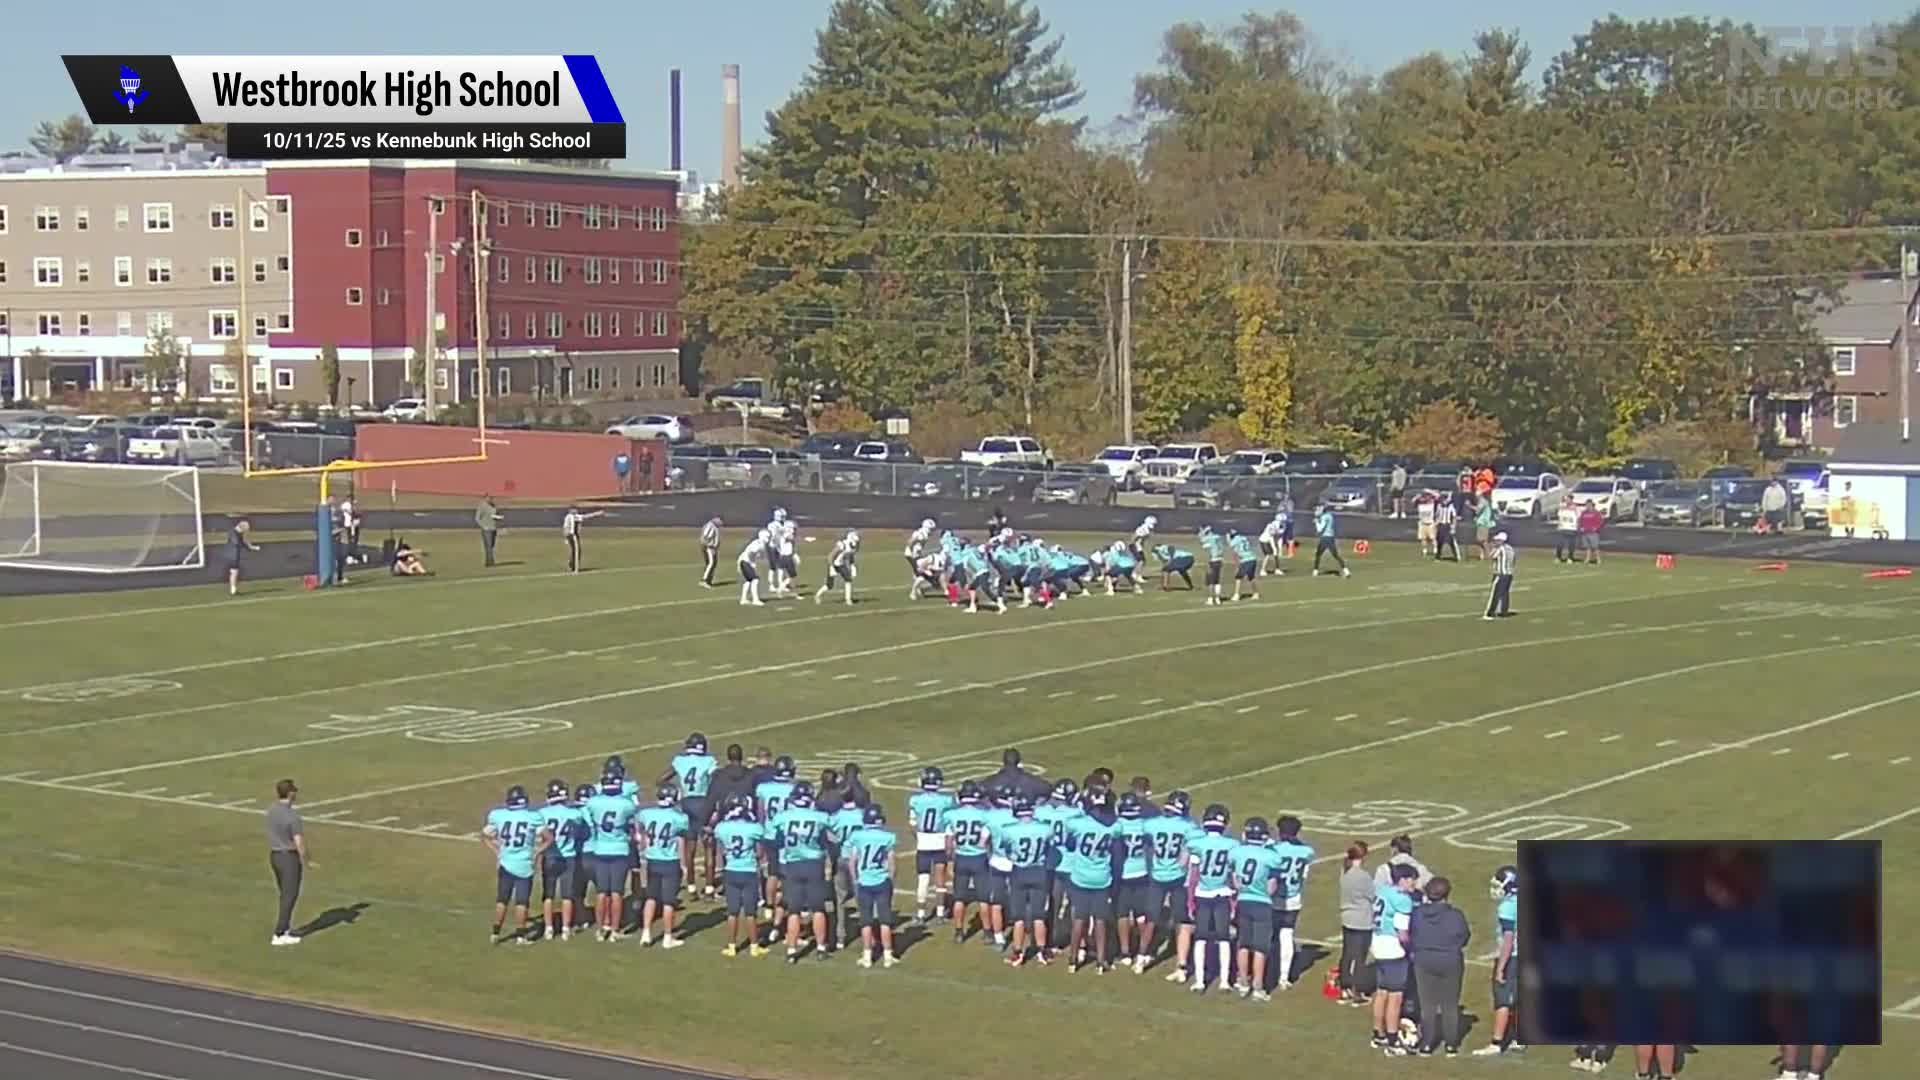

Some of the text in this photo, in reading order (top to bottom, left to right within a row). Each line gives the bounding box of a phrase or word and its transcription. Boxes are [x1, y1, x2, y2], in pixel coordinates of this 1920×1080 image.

[308, 705, 574, 743] 10
[684, 767, 697, 791] 4
[602, 812, 617, 832] 6
[923, 808, 937, 833] 0
[955, 820, 984, 846] 25
[1278, 800, 1631, 852] 30
[500, 821, 528, 847] 45
[645, 821, 672, 847] 44
[787, 821, 816, 847] 57
[1080, 832, 1112, 857] 64
[1156, 832, 1184, 858] 33
[861, 844, 885, 870] 14
[1017, 837, 1044, 863] 31
[1201, 849, 1228, 877] 19
[1241, 858, 1257, 886] 9
